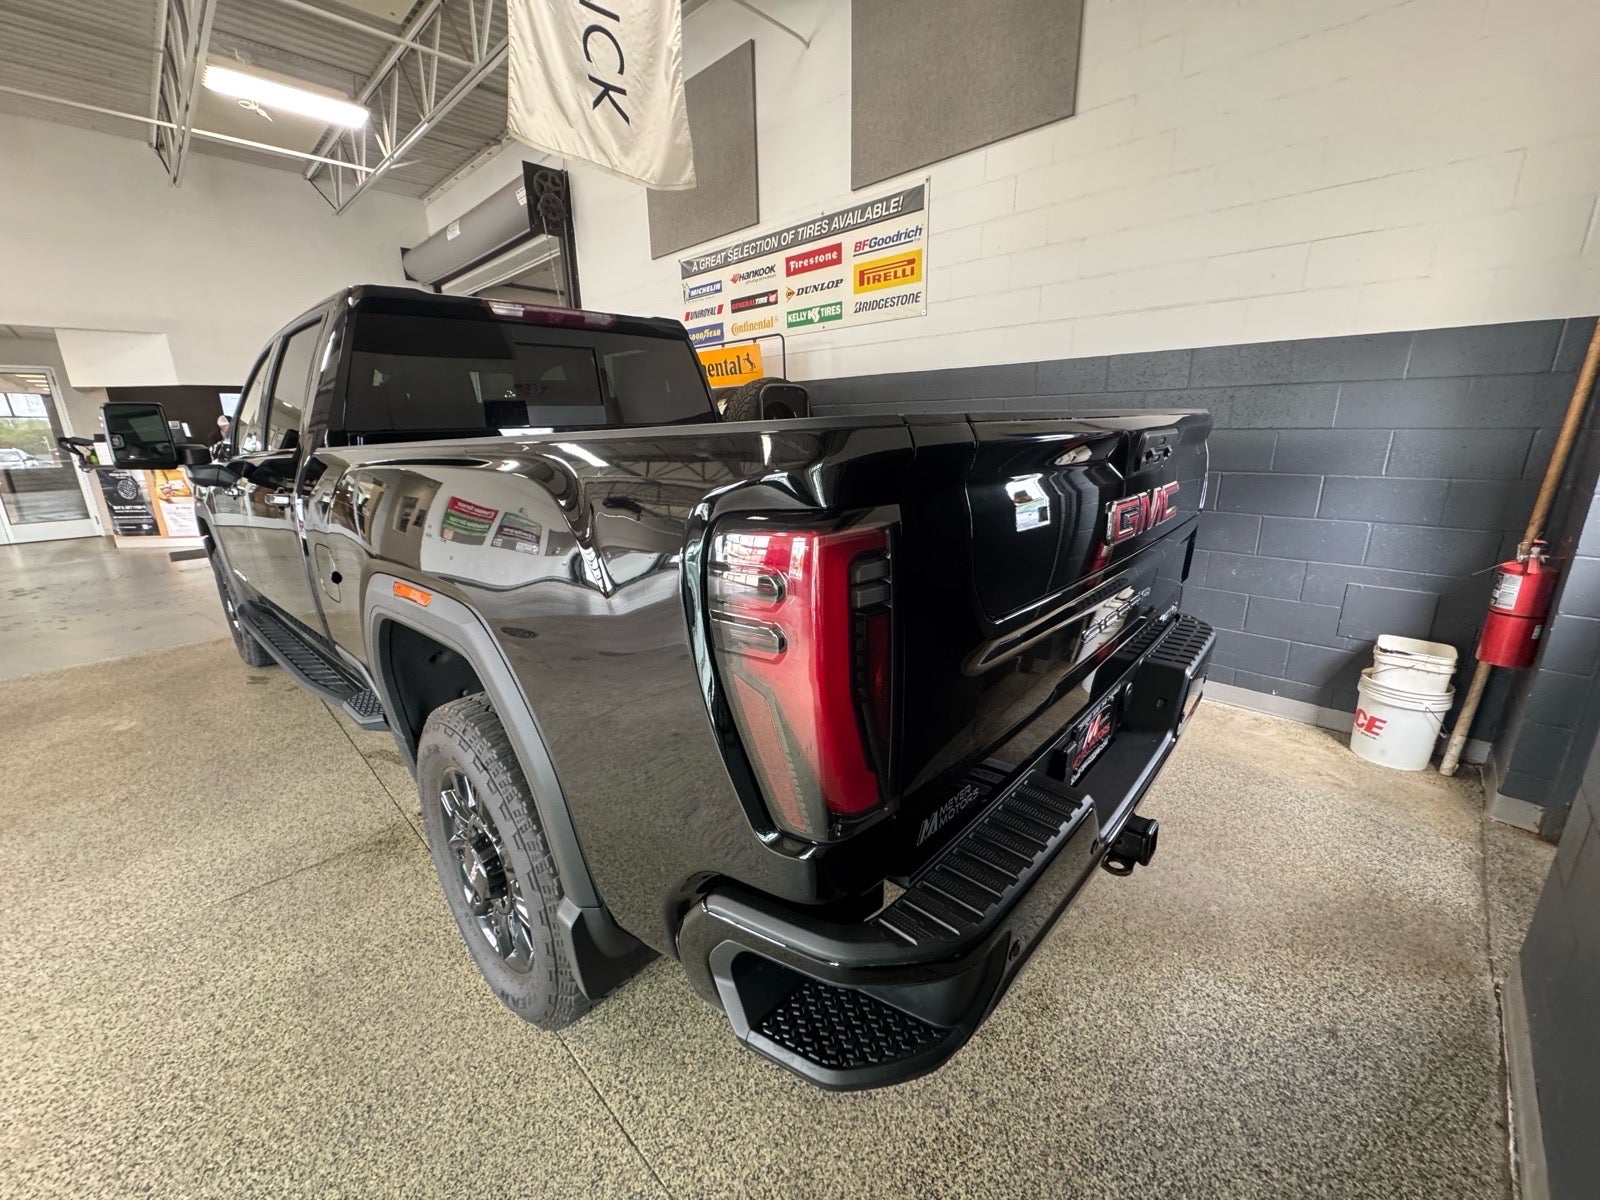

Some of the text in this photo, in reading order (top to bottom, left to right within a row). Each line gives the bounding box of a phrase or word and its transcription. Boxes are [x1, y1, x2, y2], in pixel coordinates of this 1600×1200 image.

[578, 0, 631, 126] ICK
[692, 195, 904, 273] A GREAT SELECTION OF TIRES AVAILABLE!
[853, 225, 923, 253] BFGoodrich
[789, 250, 838, 273] Firestone
[858, 257, 916, 287] PIRELLI
[690, 282, 721, 297] MICHELIN
[796, 278, 844, 297] DUNLOP
[690, 306, 717, 320] UNIROYAL
[787, 311, 807, 323] KELLY
[820, 305, 841, 316] TIRES
[853, 291, 922, 314] BRIDGESTONE
[730, 315, 775, 337] Continental
[1106, 480, 1180, 545] GMC
[1355, 708, 1388, 737] CE
[938, 783, 972, 818] MEYER
[938, 786, 979, 829] MOTORS
